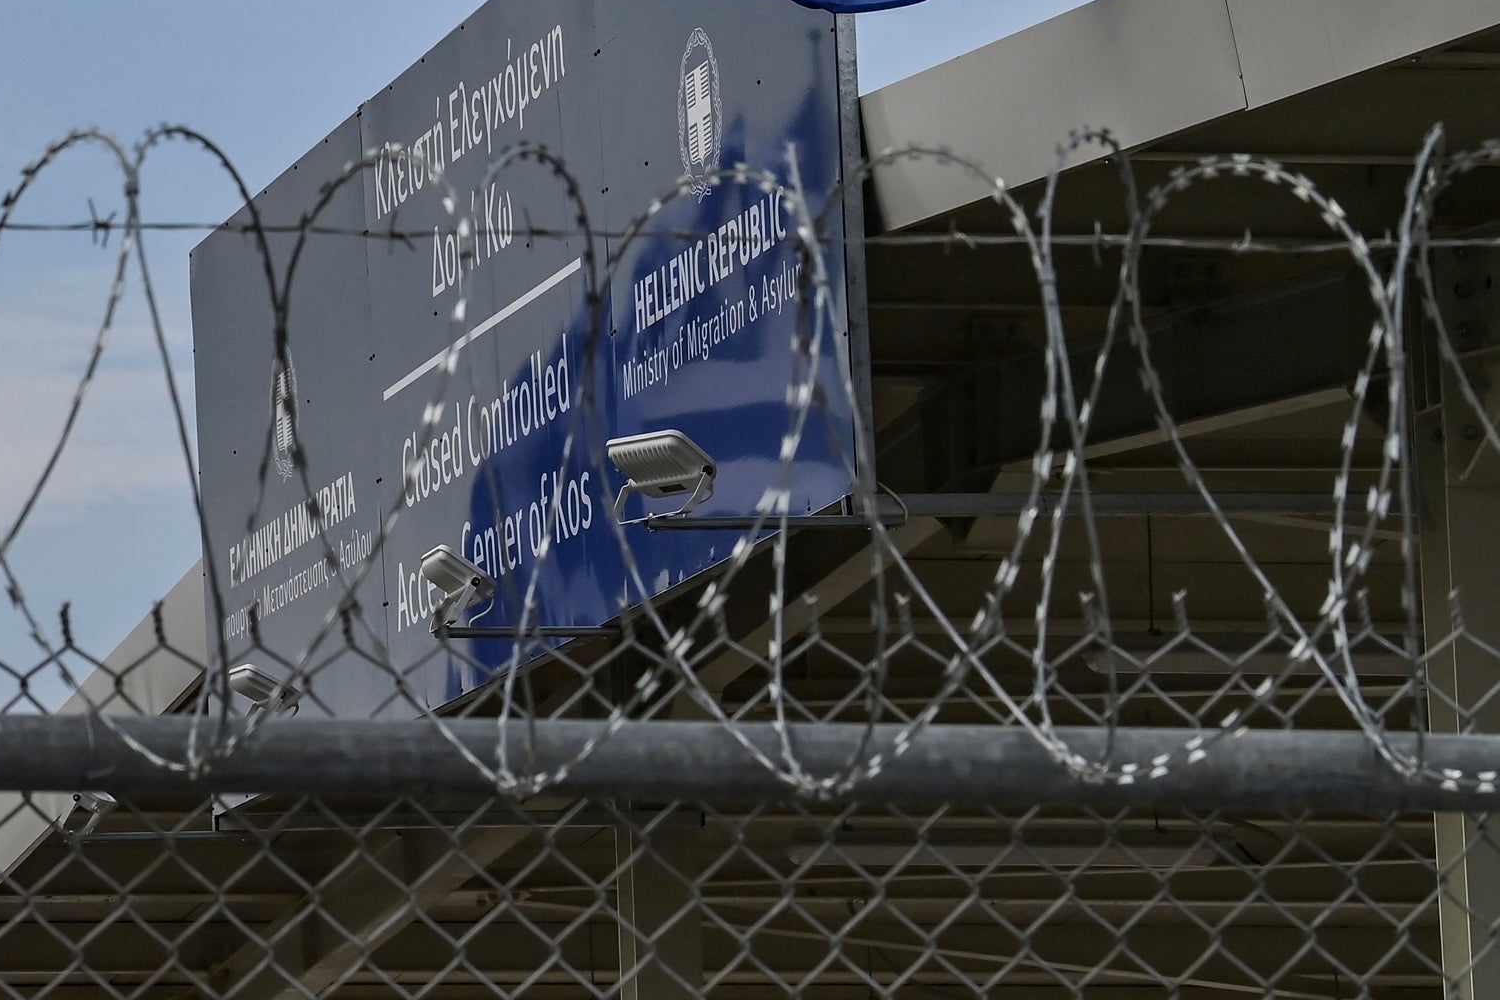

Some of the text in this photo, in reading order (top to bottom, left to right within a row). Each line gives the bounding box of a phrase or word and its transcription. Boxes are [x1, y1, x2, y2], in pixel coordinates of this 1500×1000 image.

[374, 24, 566, 220] Κλειστή Ελεγχόμενη
[484, 183, 513, 259] Κω
[634, 185, 787, 334] HELLENIC REPUBLIC
[402, 332, 571, 508] Closed Controlled
[623, 345, 669, 401] Ministry
[672, 326, 684, 370] of
[687, 298, 745, 362] Migration
[749, 284, 759, 323] &
[397, 561, 449, 633] Acce
[461, 508, 523, 579] Center
[529, 472, 548, 558] of
[552, 466, 592, 544] Kos
